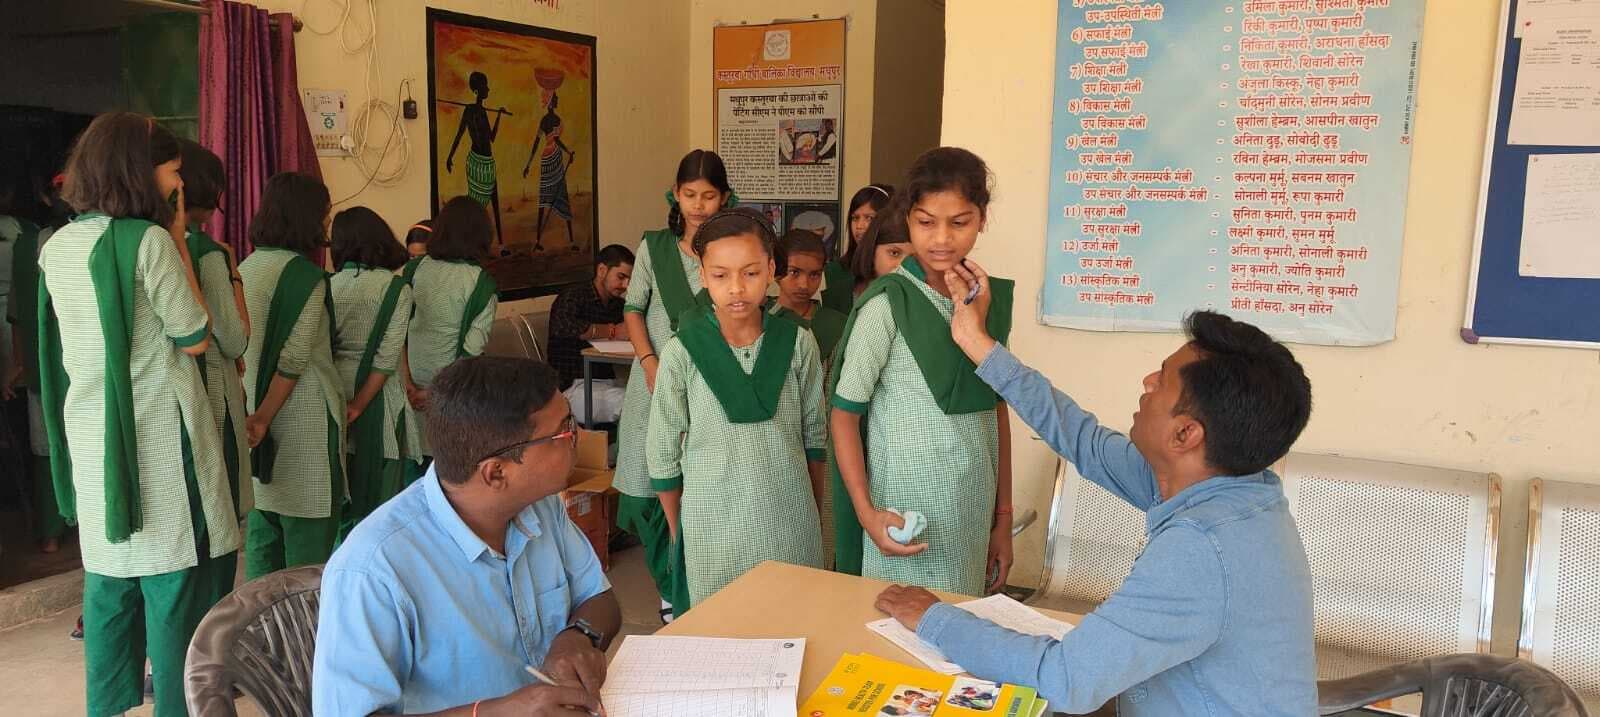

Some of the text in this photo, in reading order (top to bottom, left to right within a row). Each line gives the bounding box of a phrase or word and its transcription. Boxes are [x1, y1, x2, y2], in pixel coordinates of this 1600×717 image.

[1084, 83, 1096, 94] उप
[1082, 118, 1095, 129] उप
[1080, 154, 1092, 165] उप
[1084, 190, 1096, 201] उप
[1234, 187, 1269, 201] सोनाली
[1314, 188, 1345, 205] कुमारी
[1326, 208, 1357, 226] कुमारी
[1083, 224, 1095, 235] उप
[1299, 244, 1333, 259] सोनाली
[1336, 246, 1368, 263] कुमारी
[1081, 258, 1093, 269] उप
[1315, 264, 1345, 281] कुमारी
[1328, 283, 1359, 300] कुमारी
[1079, 292, 1091, 303] उप
